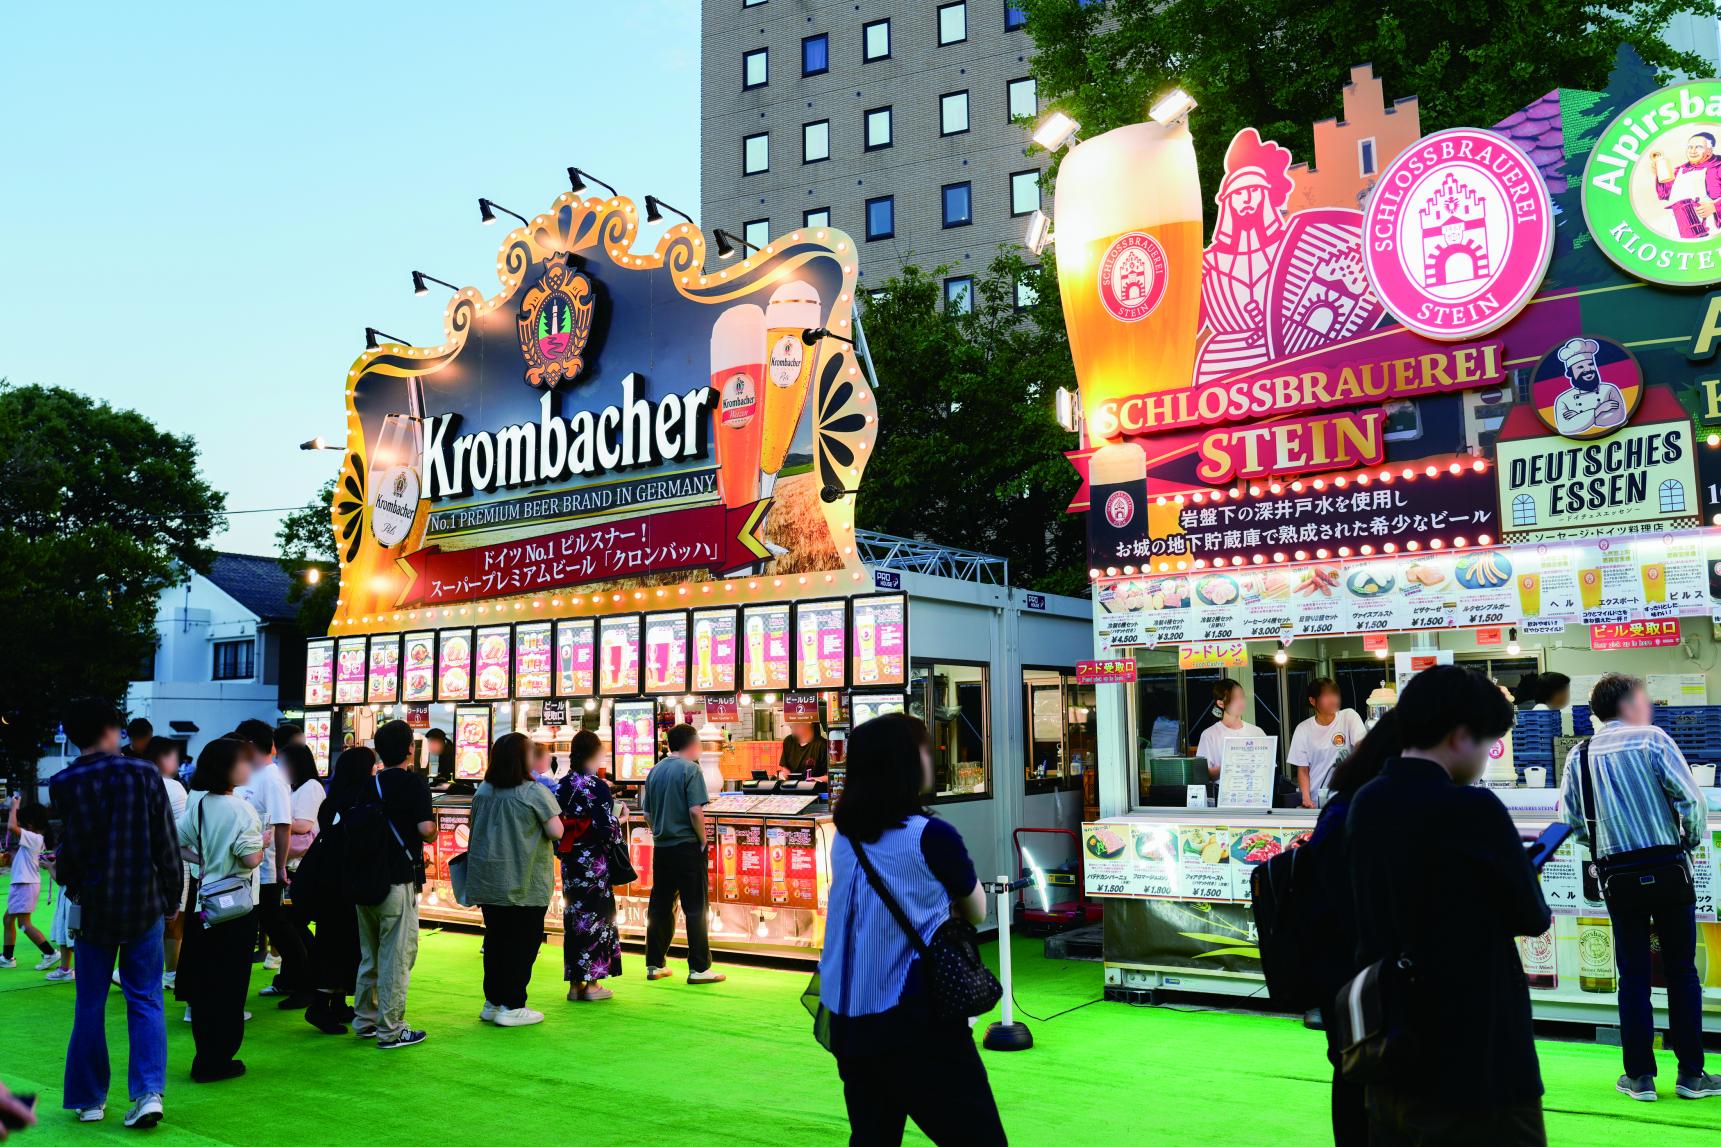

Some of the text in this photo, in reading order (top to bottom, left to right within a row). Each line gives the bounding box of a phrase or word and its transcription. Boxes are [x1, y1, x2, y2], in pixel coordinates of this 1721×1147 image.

[1374, 139, 1537, 252] SCHLOSSBRAUEREI
[1609, 220, 1721, 270] KLOSTE
[1102, 237, 1163, 286] SCHLOSSBRAUEREI
[1118, 304, 1149, 317] STEIN
[1417, 292, 1501, 325] STEIN
[771, 357, 802, 369] Krombacher
[1098, 344, 1503, 436] SCHLOSSBRAUEREI
[723, 395, 755, 409] Krombacher
[420, 372, 711, 499] Krombacher
[1200, 412, 1380, 479] STEIN
[1509, 430, 1683, 490] DEUTSCHES
[1549, 470, 1648, 517] ESSEN
[375, 493, 415, 519] Krombacher
[431, 474, 716, 532] No.1 PREMIUM BEER BRAND IN GERMANY
[1179, 489, 1408, 529] 岩盤下の深井戸水を使用し
[1115, 509, 1492, 559] お城の地下貯蔵庫で熟成された希少なビール
[1535, 523, 1664, 542] ソーセージ・ドイツ料理店
[484, 523, 648, 571] ドイツ No.1 ピルスナー！
[876, 572, 890, 582] PRO
[1356, 619, 1388, 629] ¥1,500
[1411, 616, 1443, 627] ¥1,500
[1469, 613, 1503, 624] ¥1,500
[1157, 632, 1184, 641] ¥3,200
[1204, 630, 1233, 639] ¥1,500
[1251, 626, 1281, 636] ¥3,000
[1302, 623, 1333, 633] ¥1,500
[1594, 621, 1677, 638] ビール受取口
[1181, 643, 1243, 660] フードレジ
[1078, 661, 1134, 675] フード受取口
[544, 700, 565, 710] ビール
[786, 695, 815, 704] ビールレジ
[1097, 884, 1125, 893] ¥1,500
[1192, 888, 1222, 897] ¥1,500
